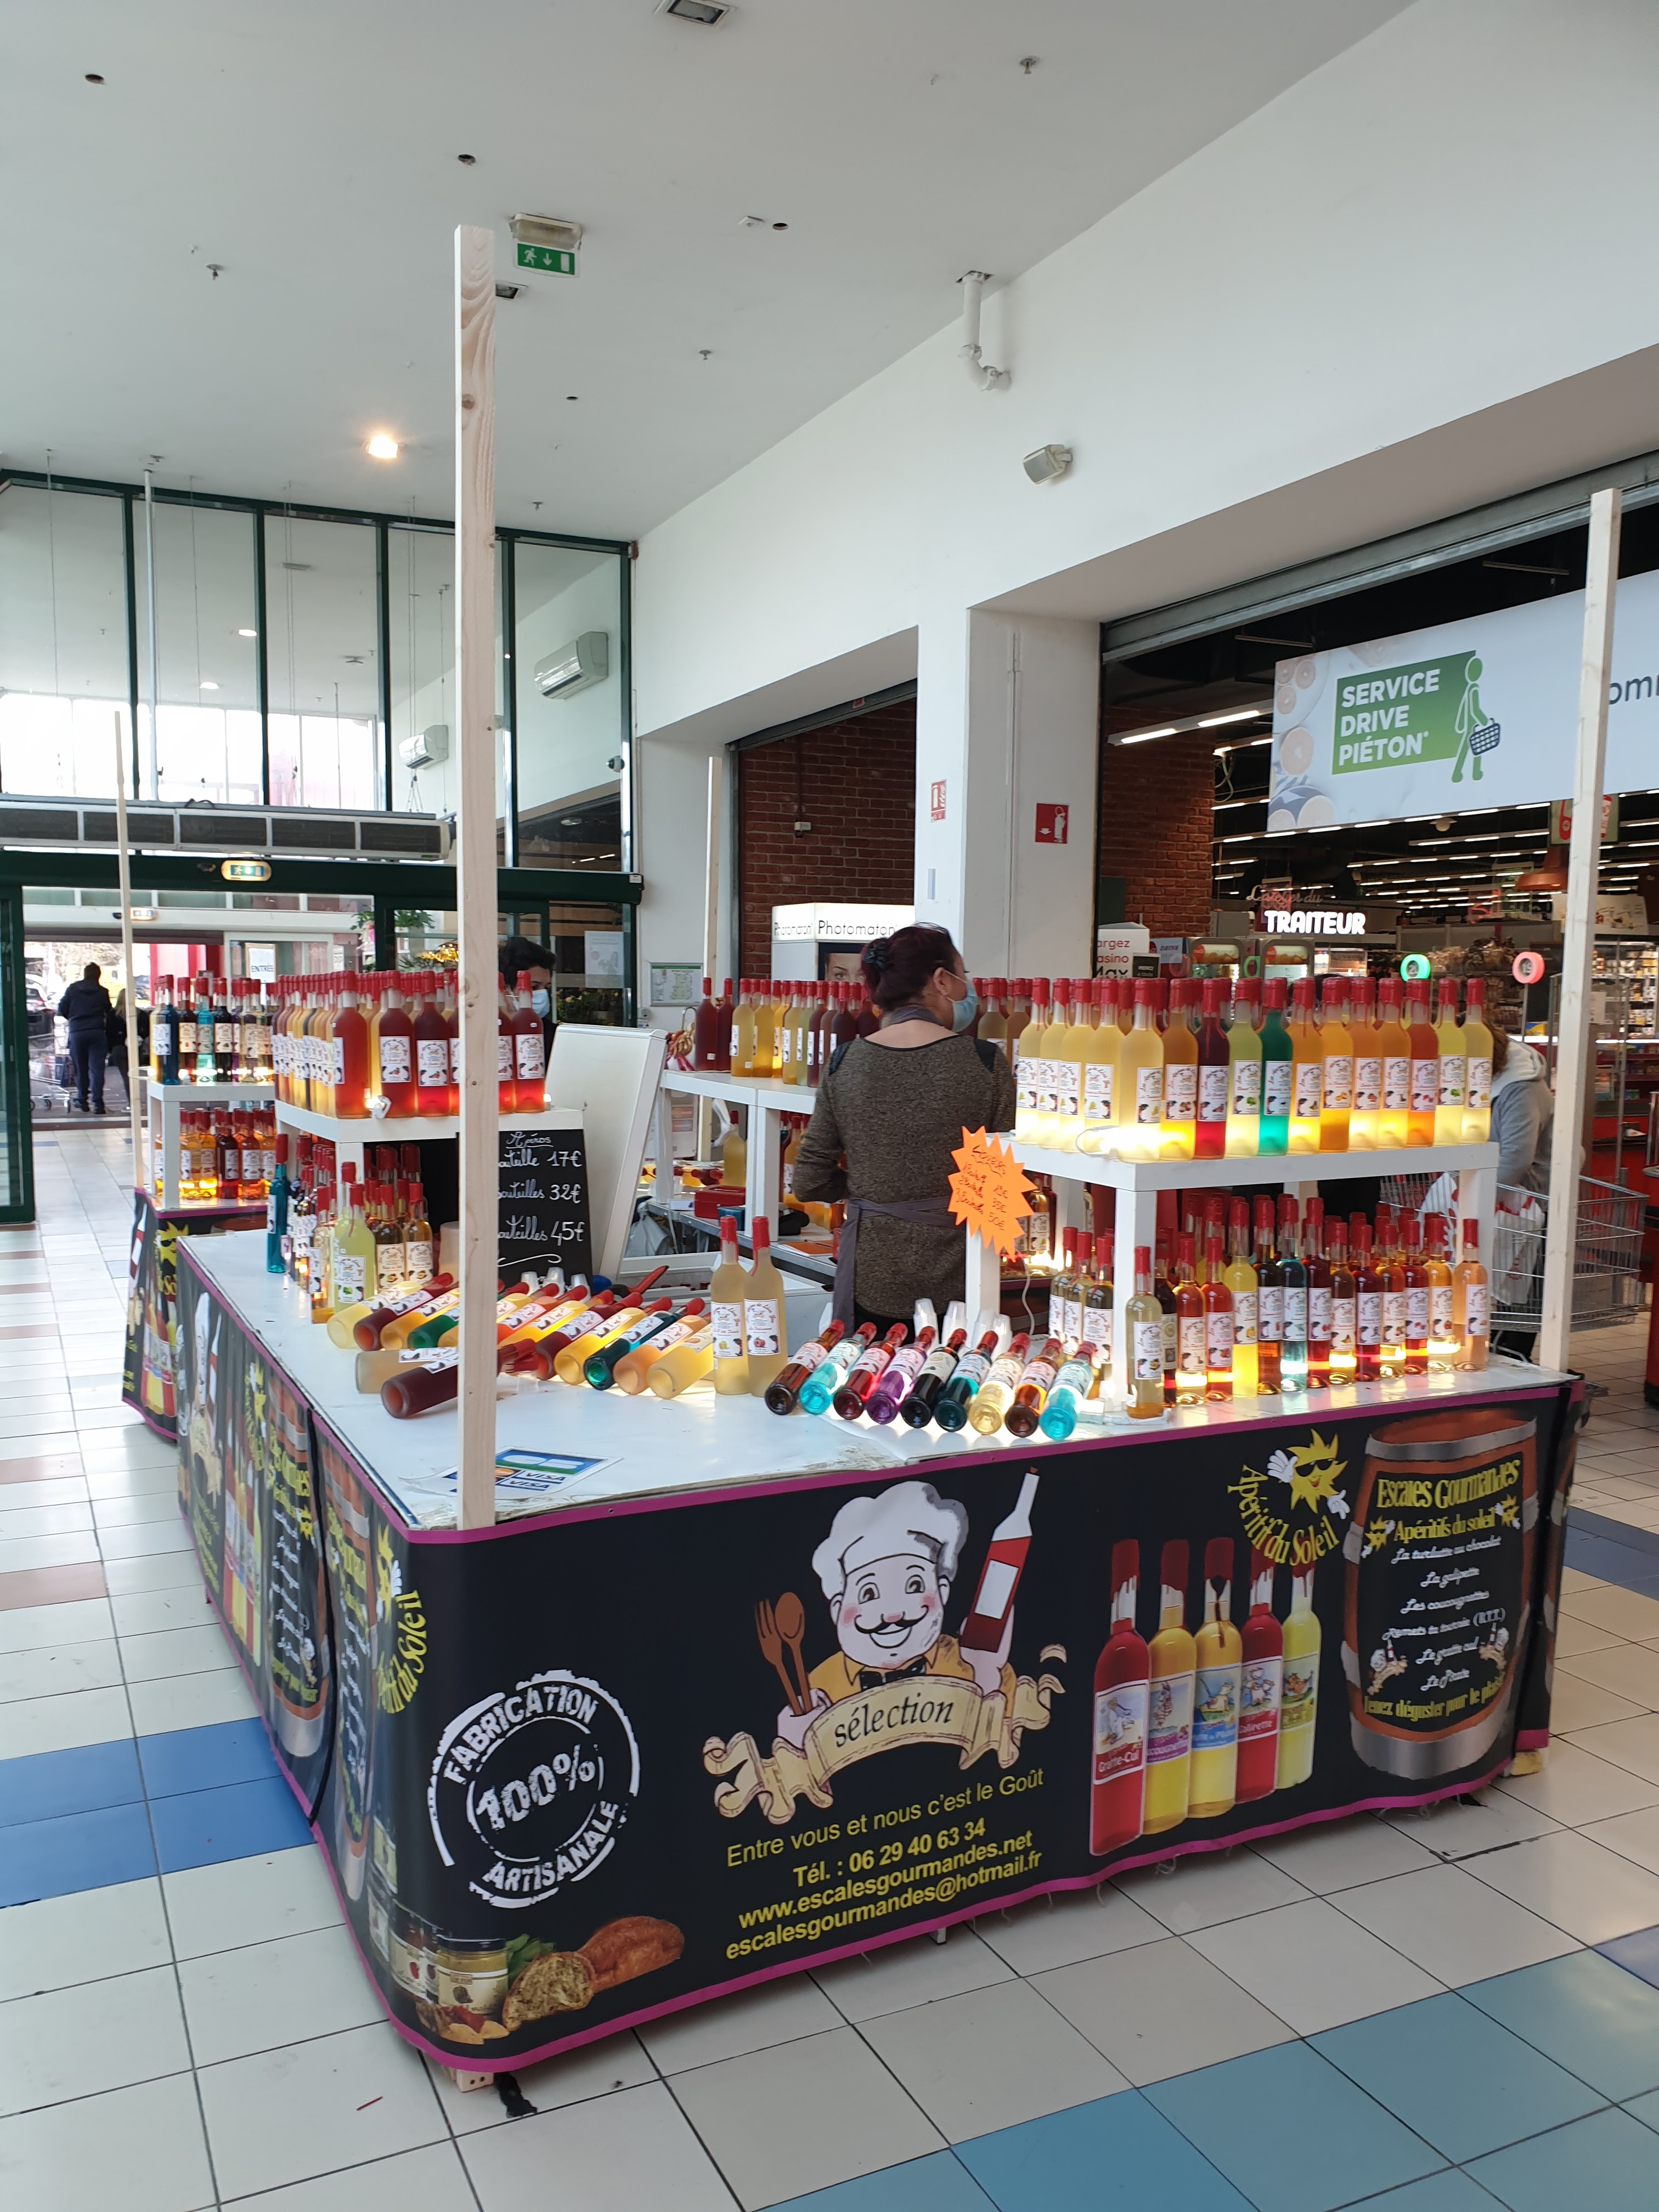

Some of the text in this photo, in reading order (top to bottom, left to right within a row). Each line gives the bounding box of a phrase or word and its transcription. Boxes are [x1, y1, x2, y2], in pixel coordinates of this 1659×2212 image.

[1341, 668, 1441, 708] SERVICE
[1340, 704, 1409, 737] DRIVE
[818, 920, 895, 935] Photomaton
[1264, 910, 1366, 935] TRAITEUR
[1097, 940, 1130, 950] argez
[1097, 953, 1129, 963] asino
[498, 1148, 583, 1167] outeille 17€
[549, 1183, 582, 1204] 32€
[498, 1215, 585, 1246] outeilles 45€
[510, 1480, 550, 1489] VISA
[525, 1472, 567, 1481] VISA
[1376, 1479, 1432, 1508] Escales
[1227, 1464, 1340, 1566] Apéritif du Soleil
[1452, 1514, 1466, 1534] du
[395, 1589, 427, 1674] Soleil
[443, 1685, 600, 1785] FABRICATION
[834, 1691, 954, 1748] sélection
[476, 1744, 596, 1831] 100%
[726, 1768, 1044, 1867] Entre vous et nous c'est le Goût
[482, 1801, 619, 1892] ARTISANALE
[793, 1860, 830, 1888] Tél.
[849, 1850, 875, 1872] 06
[879, 1842, 904, 1866] 29
[906, 1834, 932, 1857] 40
[936, 1827, 960, 1850] 63
[964, 1818, 986, 1841] 34
[738, 1830, 1033, 1928] www.escalesgourmandes.net
[725, 1850, 1042, 1960] escalesgourmandes@hotmail.fr
